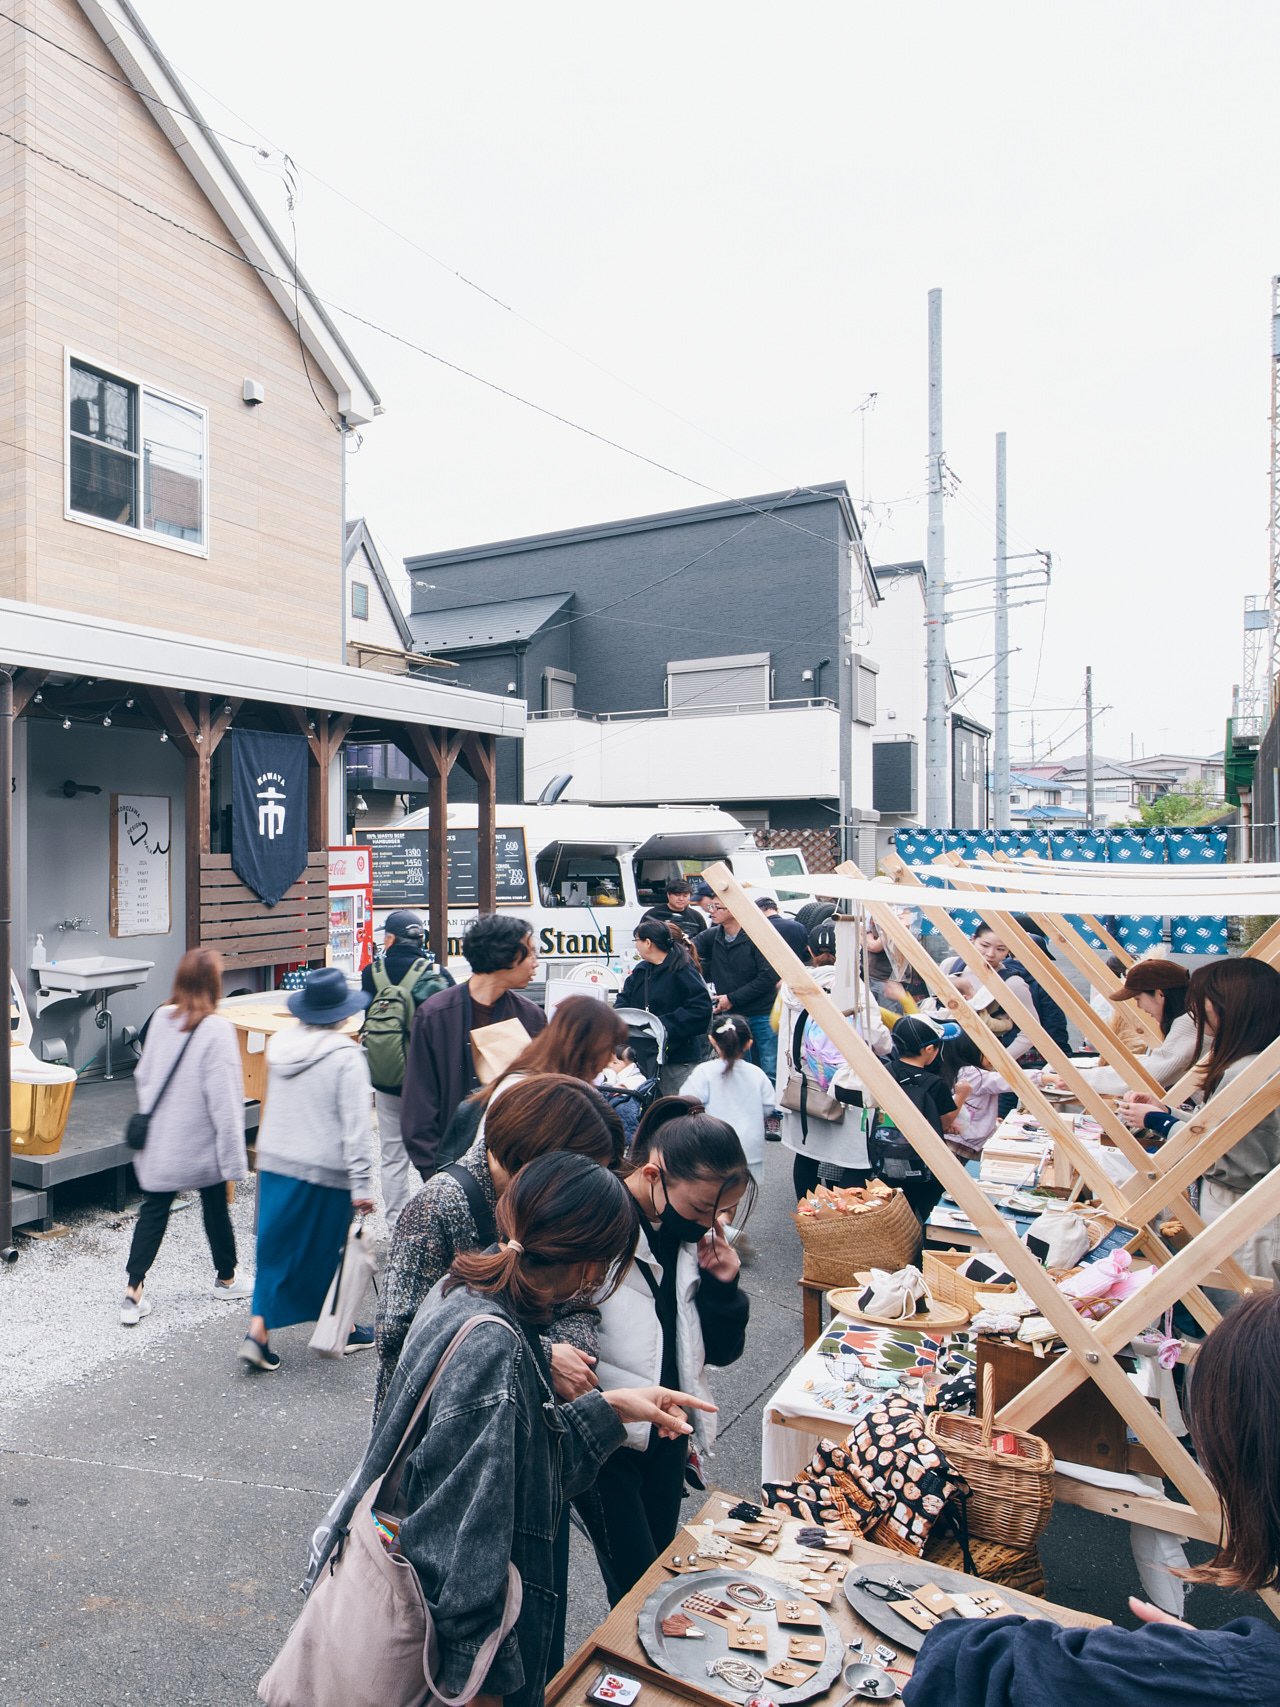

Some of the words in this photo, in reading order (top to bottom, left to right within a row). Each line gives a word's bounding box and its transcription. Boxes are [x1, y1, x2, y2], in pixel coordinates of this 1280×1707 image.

[256, 772, 286, 787] KAWAYA
[256, 787, 287, 840] 市
[539, 925, 614, 954] Stand
